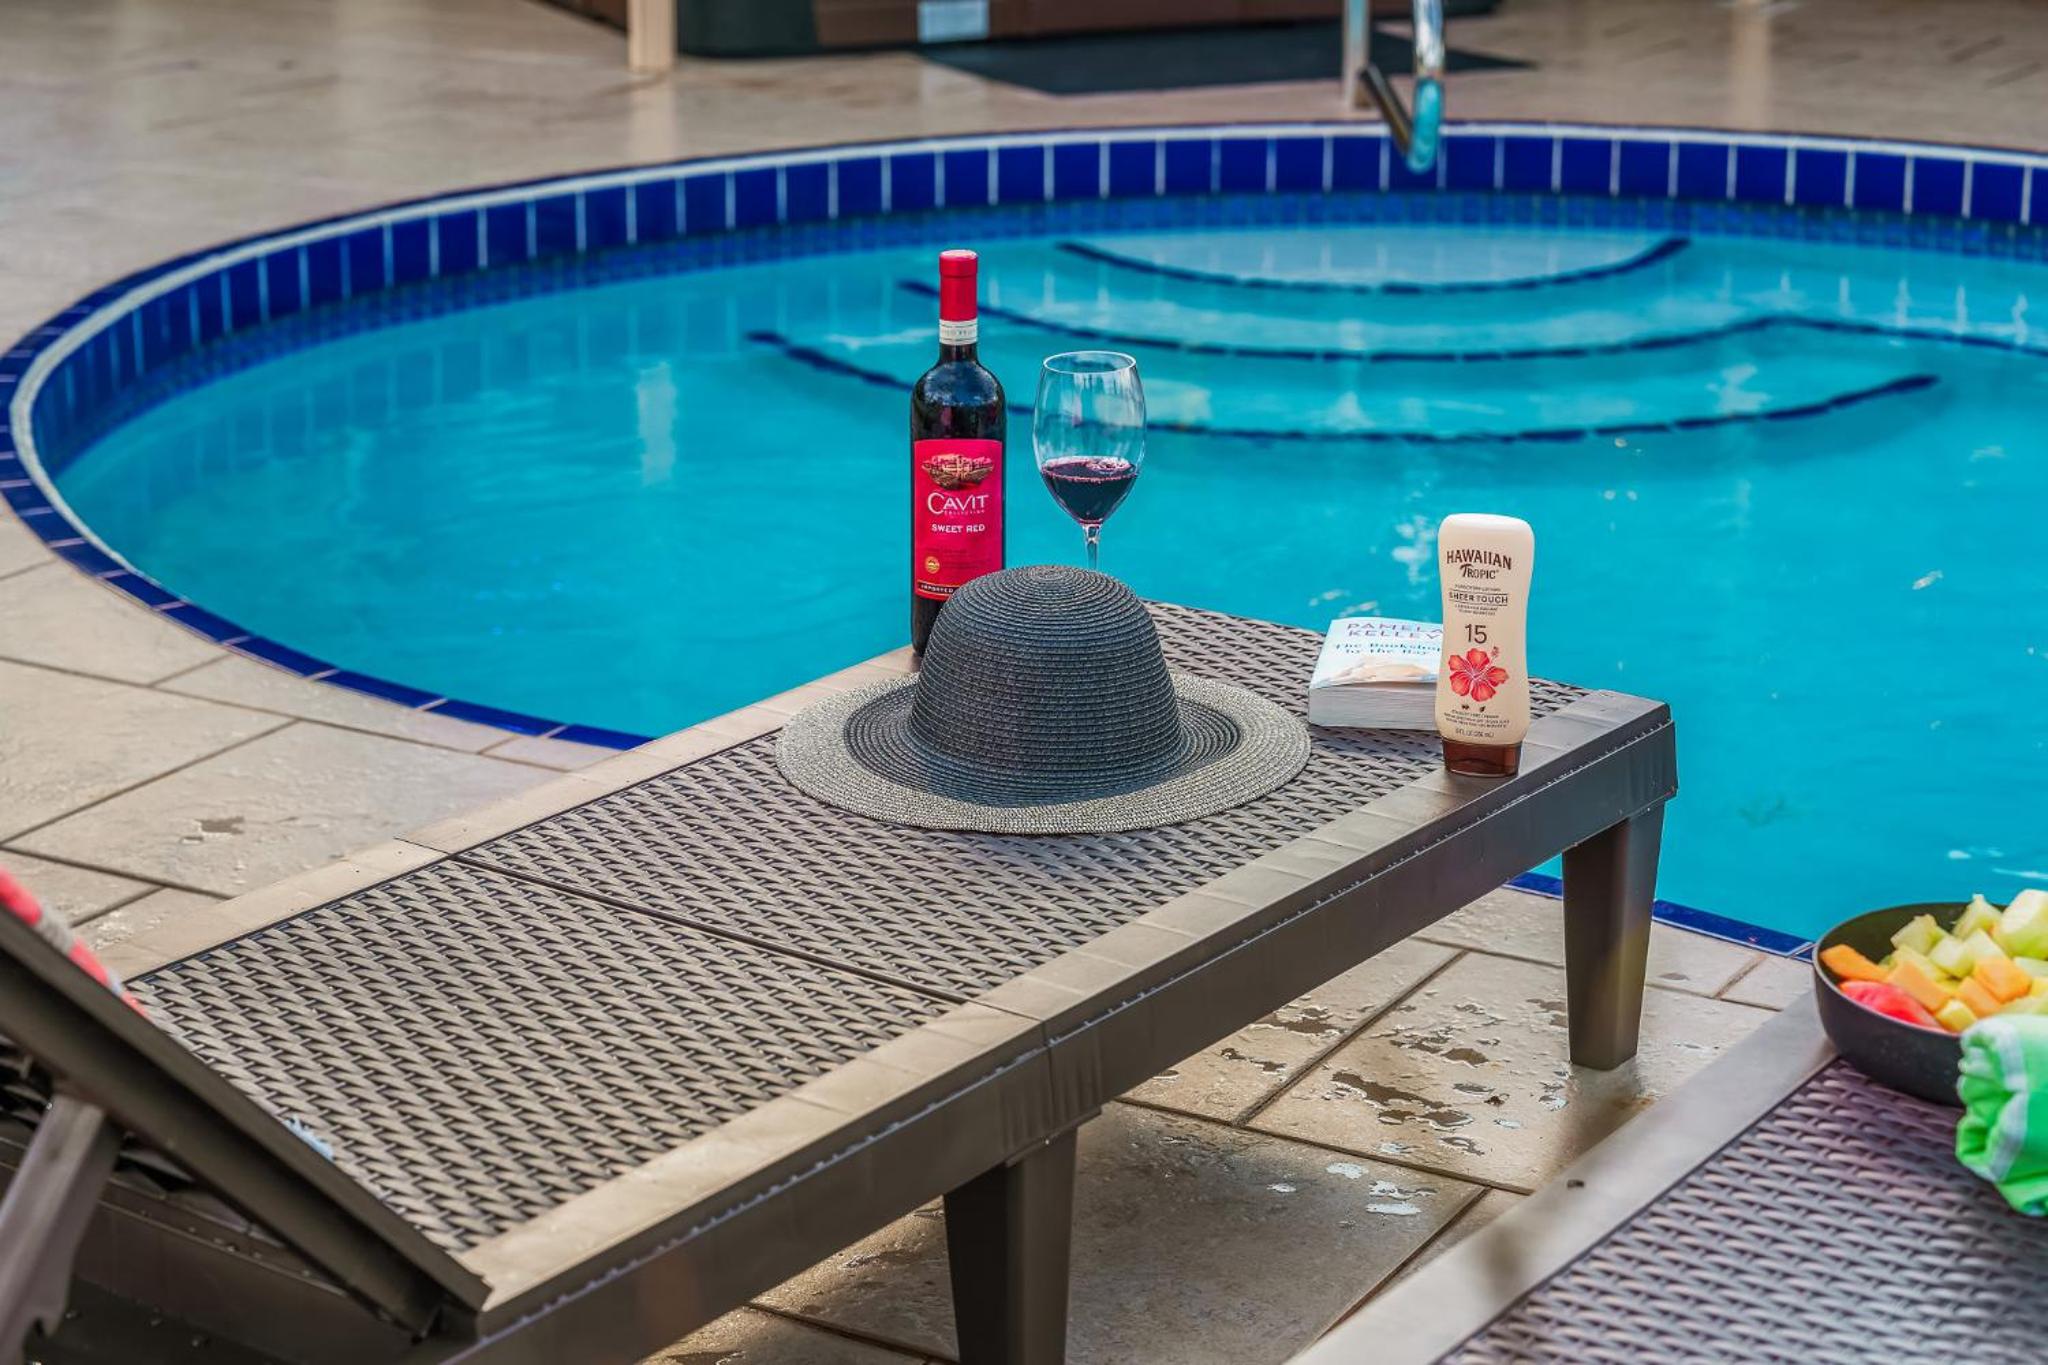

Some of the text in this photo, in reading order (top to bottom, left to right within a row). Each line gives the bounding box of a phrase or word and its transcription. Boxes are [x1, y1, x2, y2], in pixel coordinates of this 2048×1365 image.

[927, 491, 989, 515] CAVIT
[931, 523, 986, 533] SWEET RED
[1446, 549, 1512, 570] HAWAIIAN
[920, 584, 954, 593] IMPORTED
[1449, 591, 1509, 604] SHEER TOUCH
[1348, 630, 1441, 639] KELLEY
[1464, 623, 1488, 644] 15
